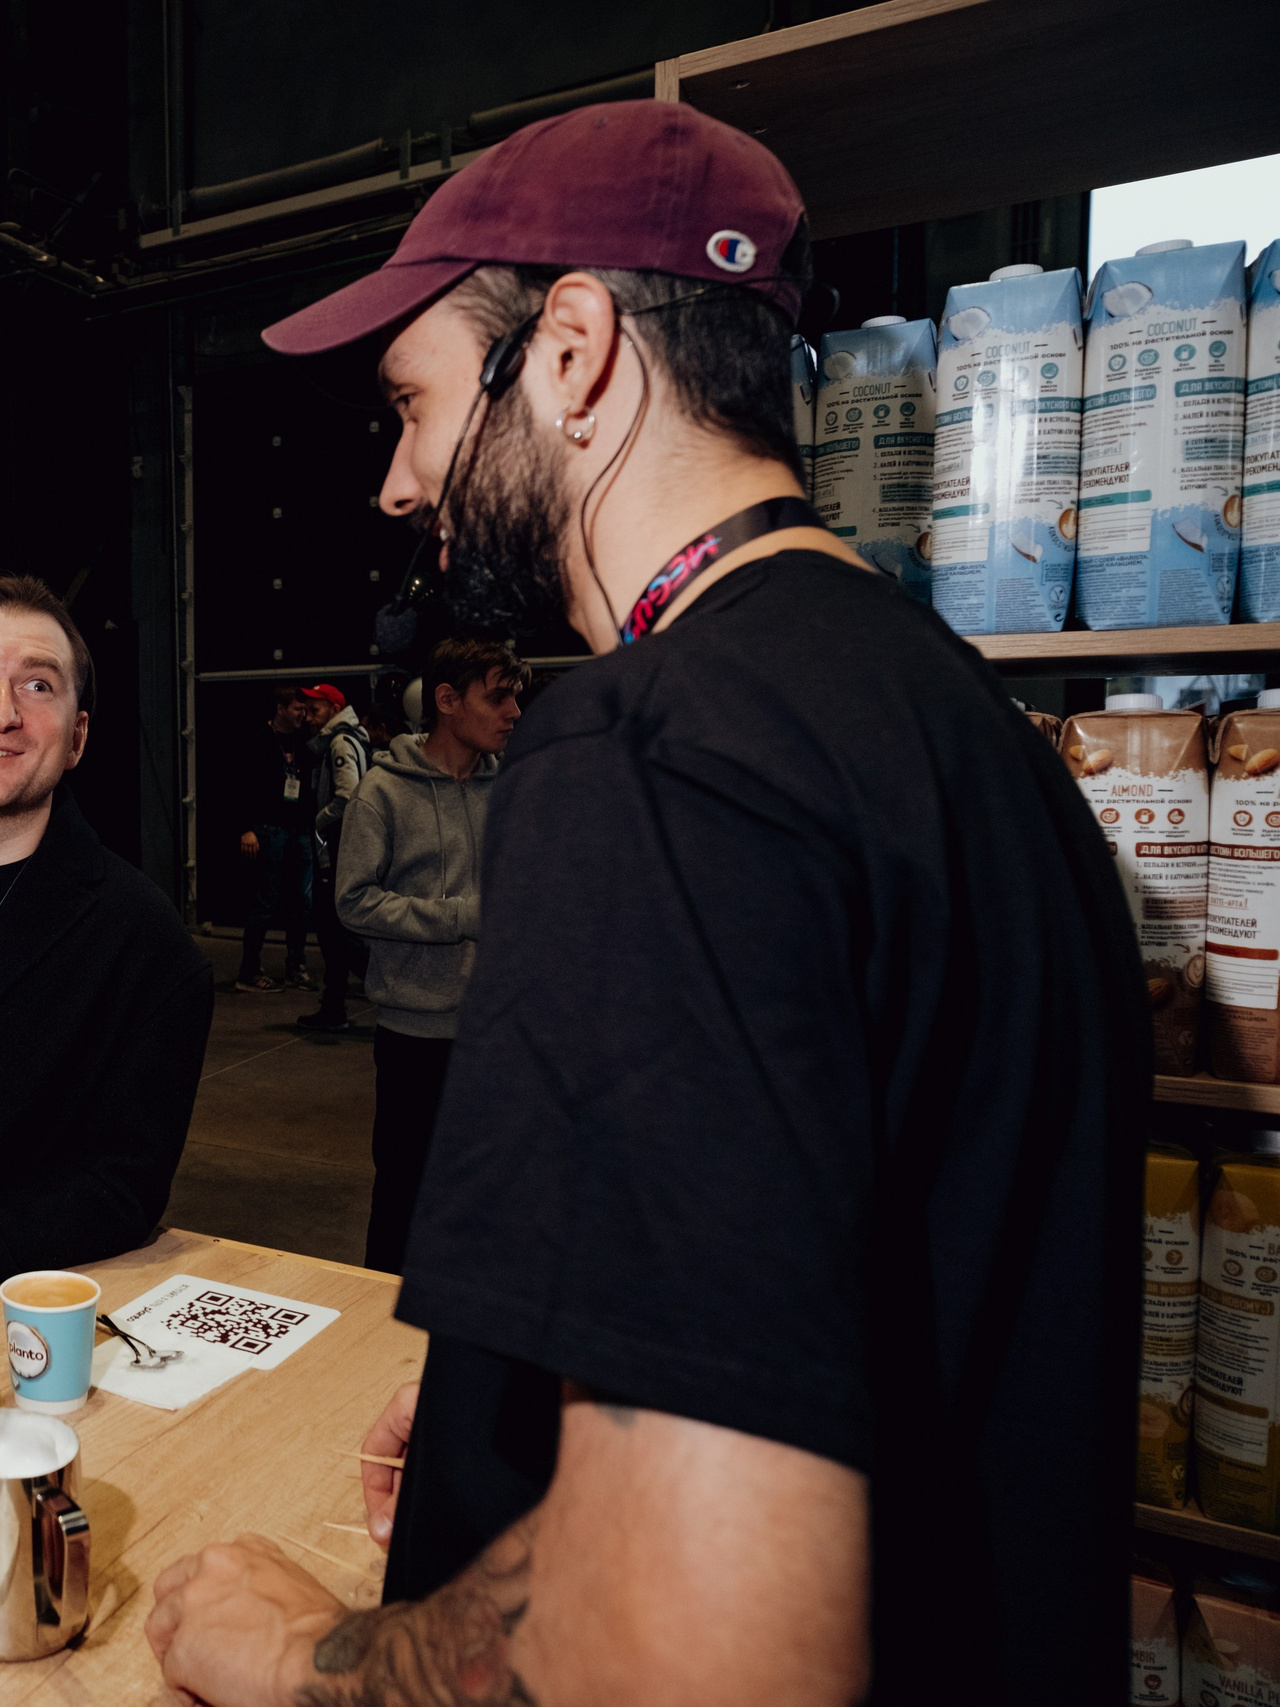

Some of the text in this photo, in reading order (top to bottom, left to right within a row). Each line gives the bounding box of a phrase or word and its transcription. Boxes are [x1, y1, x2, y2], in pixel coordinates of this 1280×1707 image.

[1147, 318, 1198, 337] COCONUT
[1110, 342, 1129, 350] 100%
[1145, 331, 1206, 345] растительной
[986, 342, 1030, 358] COCONUT
[853, 382, 891, 397] COCONUT
[1180, 383, 1201, 393] ДЛЯ
[826, 400, 839, 408] 100%
[851, 393, 898, 403] растительной
[1109, 388, 1154, 404] БОЛЬШЕГО!
[878, 437, 895, 445] ДЛЯ
[934, 488, 970, 501] КОМЕНДУЮТ
[1111, 785, 1153, 796] ALMOND
[1139, 845, 1196, 855] ДЛЯ ВКУСНОГО
[1209, 846, 1232, 857] ОСТОИН
[9, 1342, 44, 1361] planto
[1218, 1674, 1263, 1700] VANILLA
